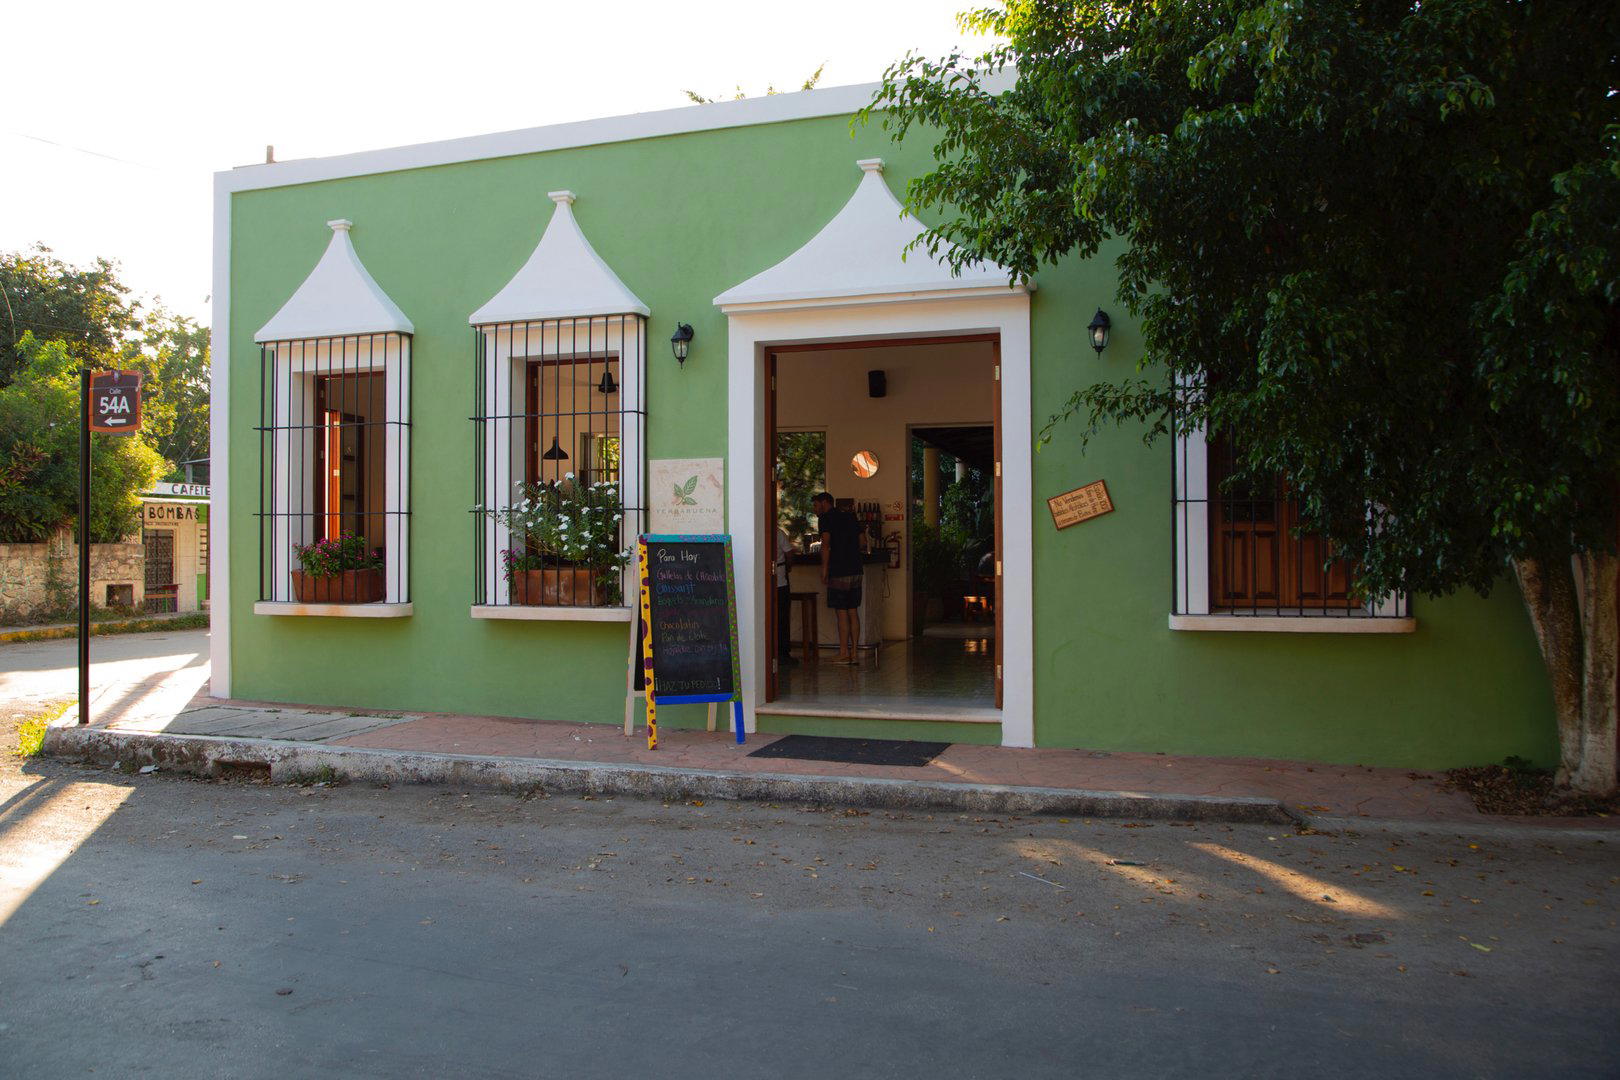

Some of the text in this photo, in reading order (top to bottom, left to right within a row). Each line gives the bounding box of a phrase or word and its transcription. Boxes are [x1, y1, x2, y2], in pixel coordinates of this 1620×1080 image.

[99, 395, 130, 414] 54A
[149, 506, 200, 520] BOMBAS
[657, 548, 676, 564] Para
